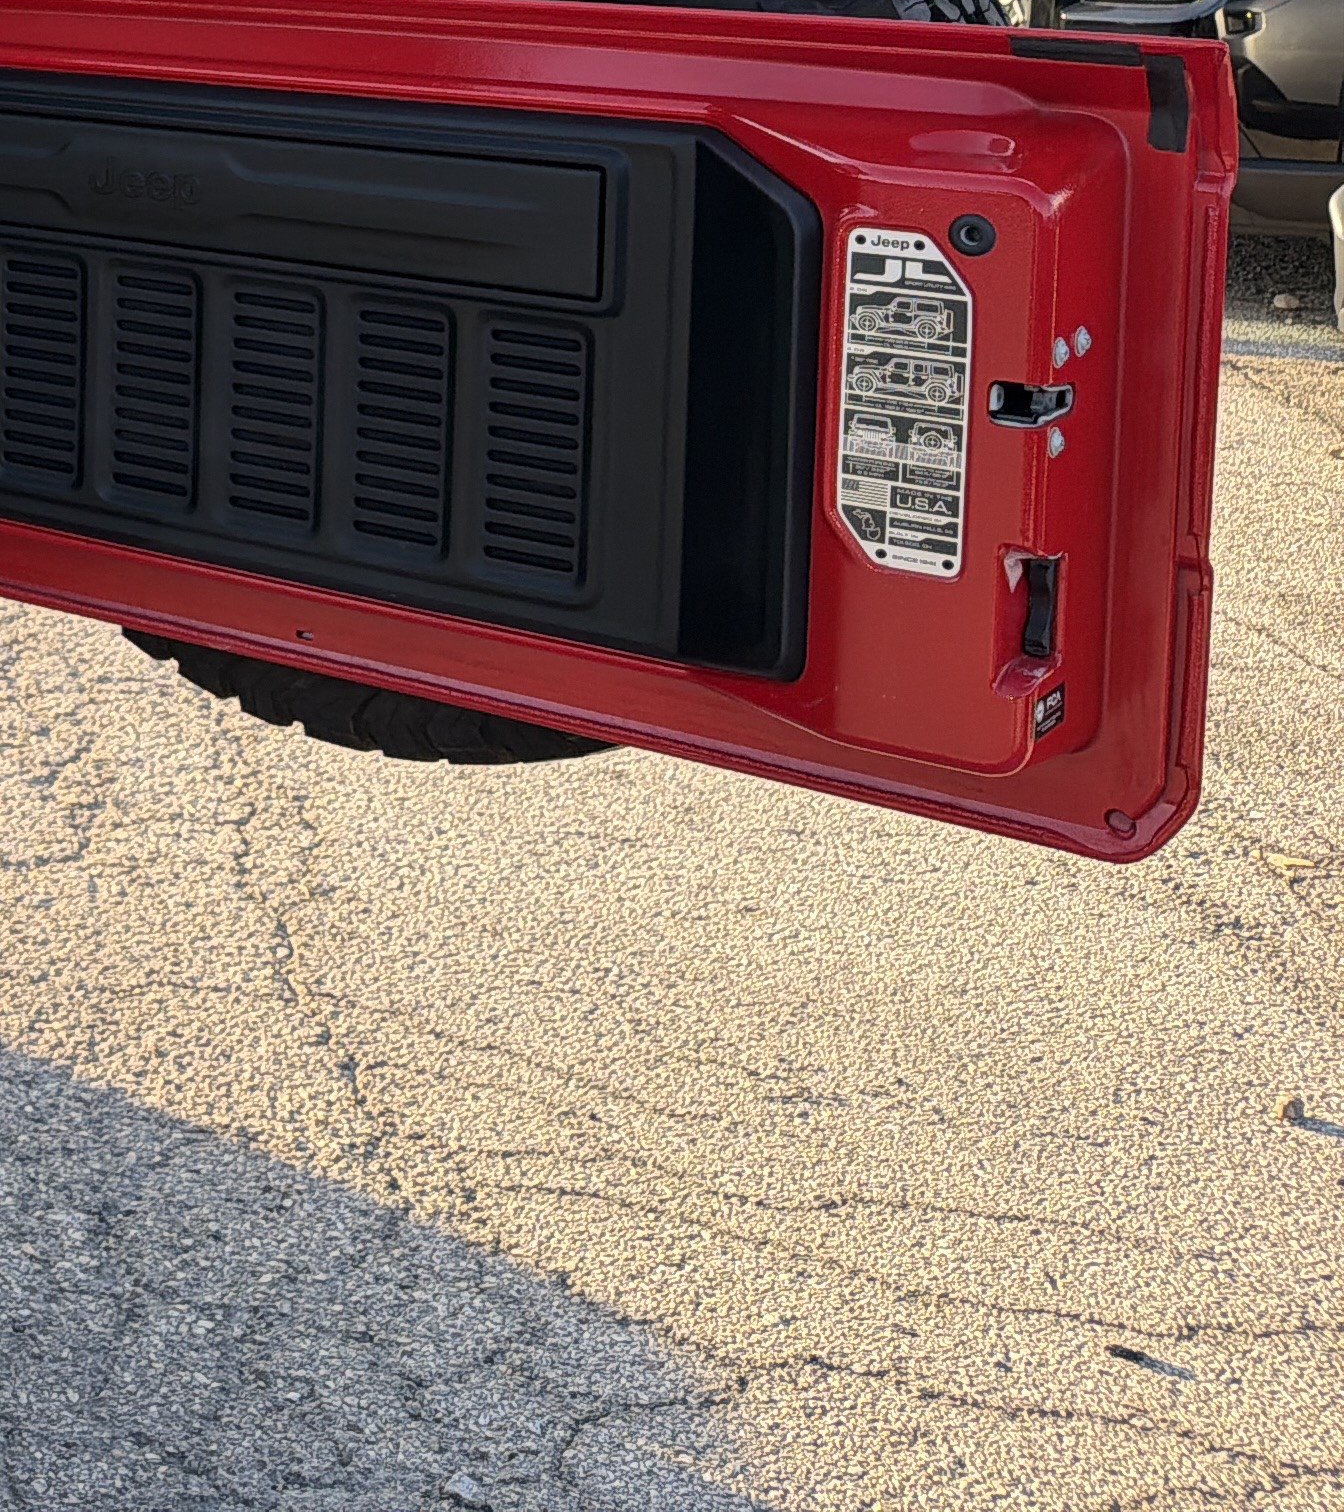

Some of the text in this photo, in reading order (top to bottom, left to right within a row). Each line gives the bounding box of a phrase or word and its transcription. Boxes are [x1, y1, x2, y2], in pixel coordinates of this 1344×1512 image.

[87, 155, 201, 212] Jeep
[870, 234, 910, 251] Jeep
[853, 258, 952, 284] JL
[896, 488, 923, 497] MADE
[896, 494, 952, 515] U.S.A.
